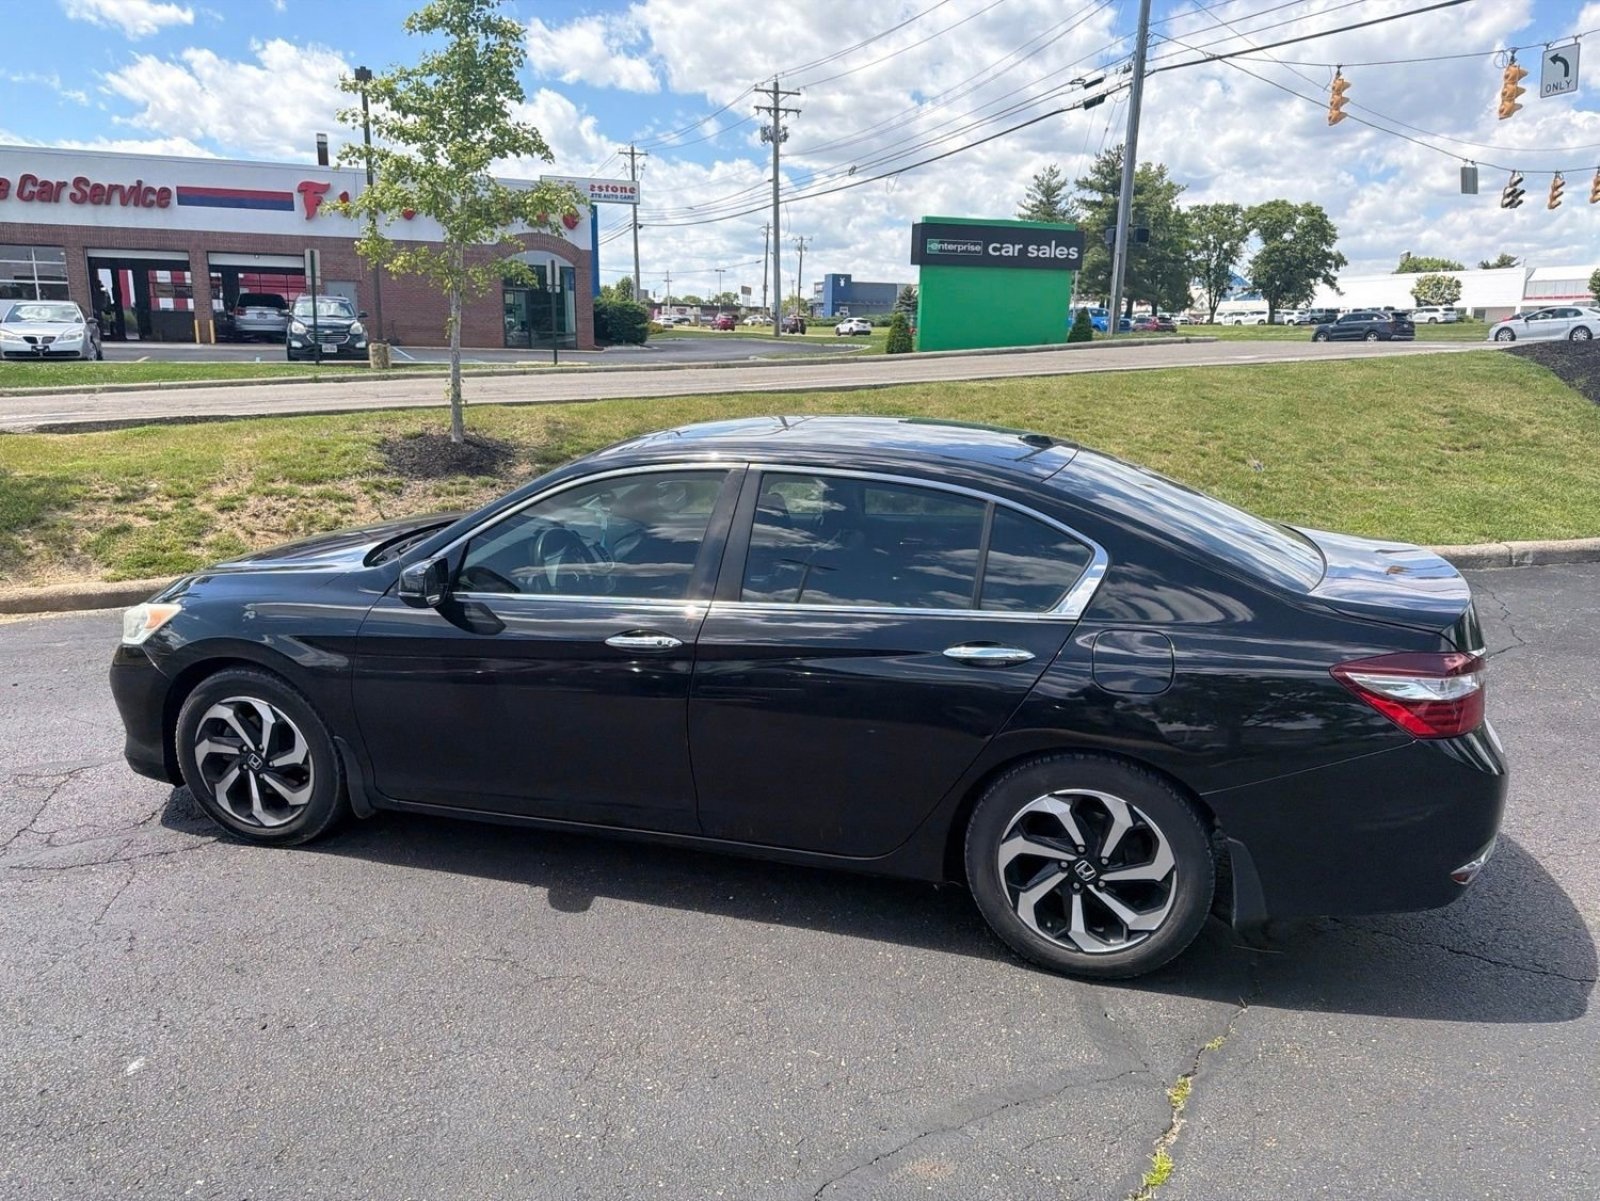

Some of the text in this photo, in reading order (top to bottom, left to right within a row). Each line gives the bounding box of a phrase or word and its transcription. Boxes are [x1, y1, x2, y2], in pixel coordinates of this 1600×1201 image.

[1545, 80, 1572, 93] ONLY
[17, 173, 68, 203] Car
[69, 176, 172, 209] Service
[929, 240, 1079, 260] enterprise car sales
